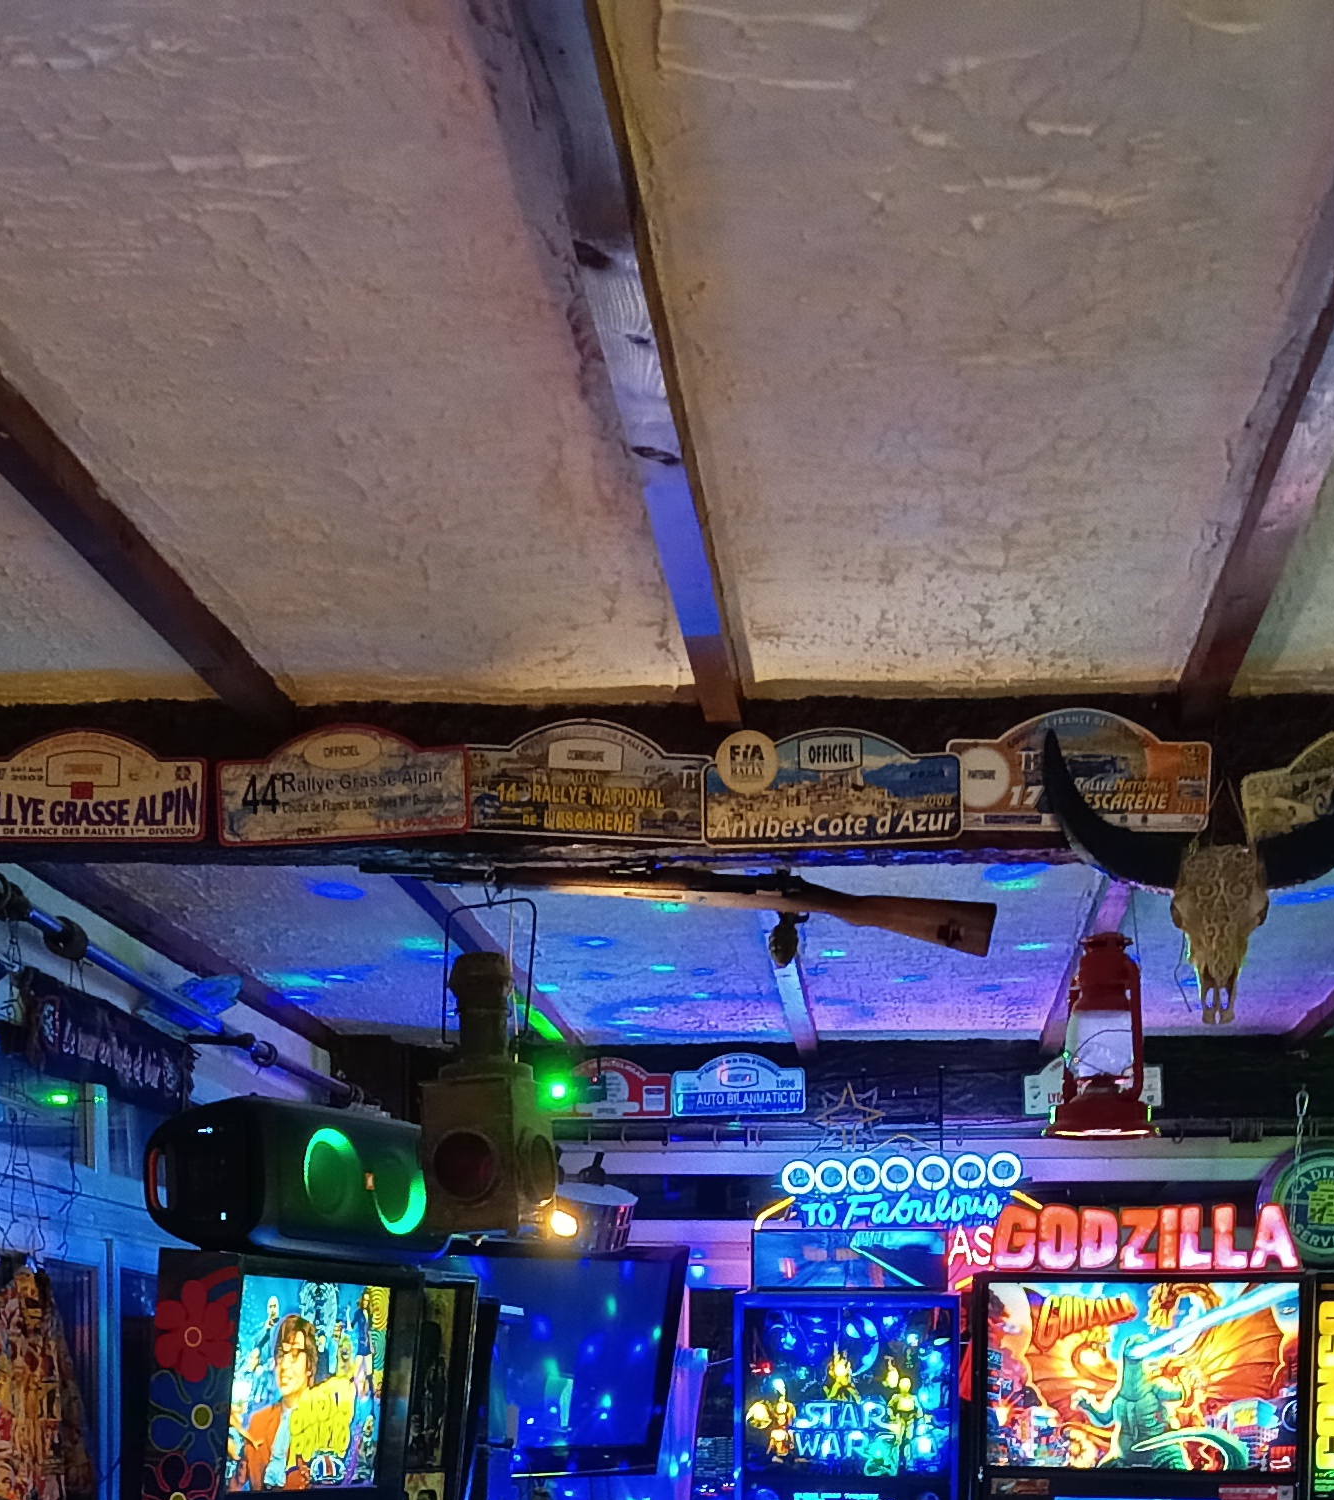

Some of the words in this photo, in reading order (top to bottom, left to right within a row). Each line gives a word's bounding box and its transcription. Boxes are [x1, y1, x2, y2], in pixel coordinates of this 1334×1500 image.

[808, 743, 855, 764] OFFICIEL
[281, 772, 336, 794] Rallye
[339, 773, 397, 790] Grasse
[402, 769, 443, 788] Alpin
[50, 798, 131, 827] GRASSE
[133, 780, 199, 826] ALPIN
[532, 785, 587, 806] RALLYE
[591, 786, 665, 809] NATIONAL
[18, 826, 58, 836] FRANCE
[876, 809, 956, 835] d'Azur
[696, 1092, 725, 1107] AUTO
[800, 1202, 837, 1227] TO
[841, 1189, 1002, 1231] Fabulous
[992, 1202, 1304, 1271] GODZILLA
[1035, 1292, 1138, 1351] GODZILLA
[794, 1401, 888, 1430] STAR
